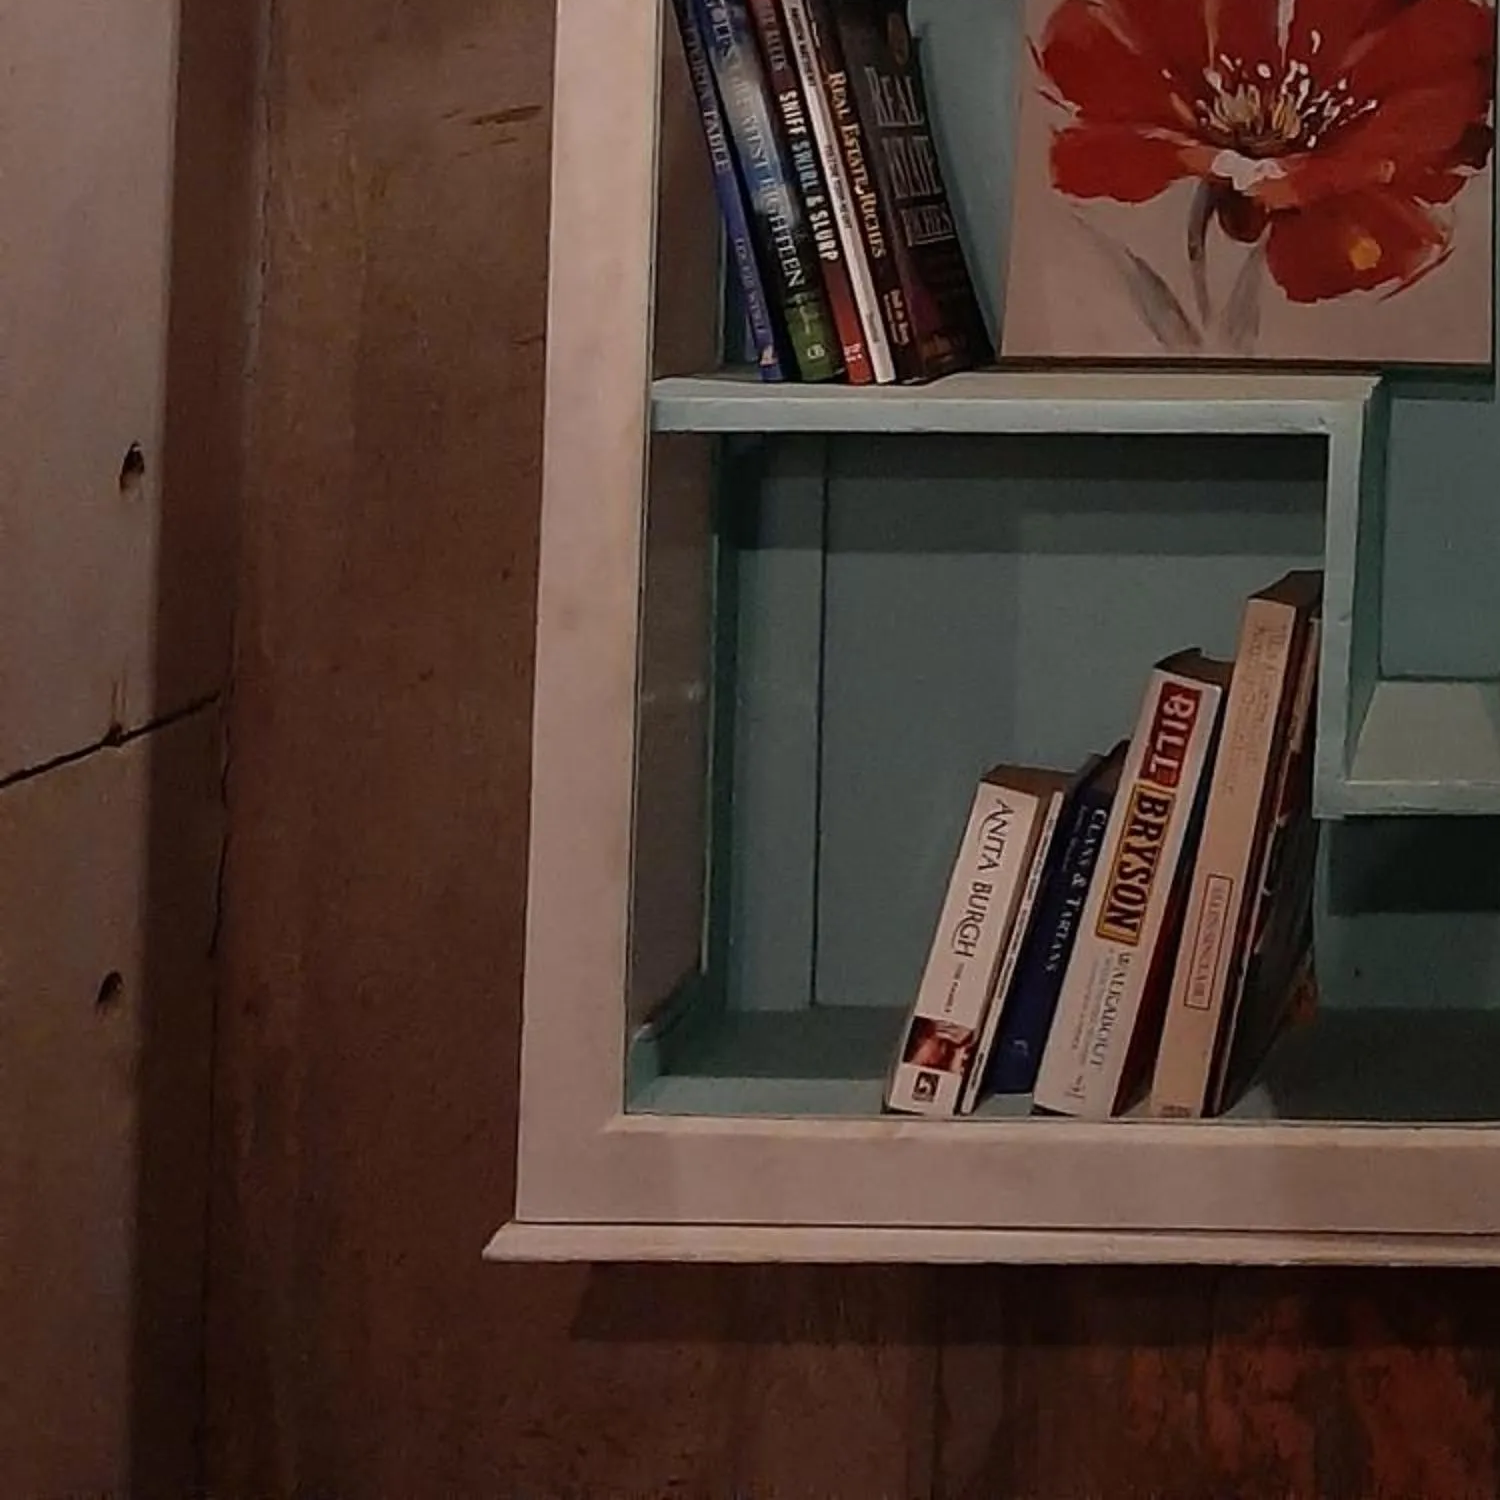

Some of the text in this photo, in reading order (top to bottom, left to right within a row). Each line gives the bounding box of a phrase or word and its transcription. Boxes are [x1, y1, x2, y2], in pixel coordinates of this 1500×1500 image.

[777, 89, 808, 138] SNIFF
[825, 69, 856, 120] REAL
[864, 66, 926, 128] REAL
[701, 107, 732, 174] TABLE
[790, 139, 822, 192] SWIRL
[839, 122, 873, 184] ESTATE
[758, 176, 805, 288] EIGHTEEN
[808, 208, 840, 264] SLURP
[856, 191, 891, 258] RICHES
[1103, 691, 1196, 932] BILL BRYSON
[946, 796, 1018, 961] ANITA BURGH
[1069, 871, 1088, 889] &
[1041, 893, 1082, 974] TARTANS
[1087, 949, 1132, 1071] WALKABOUT
